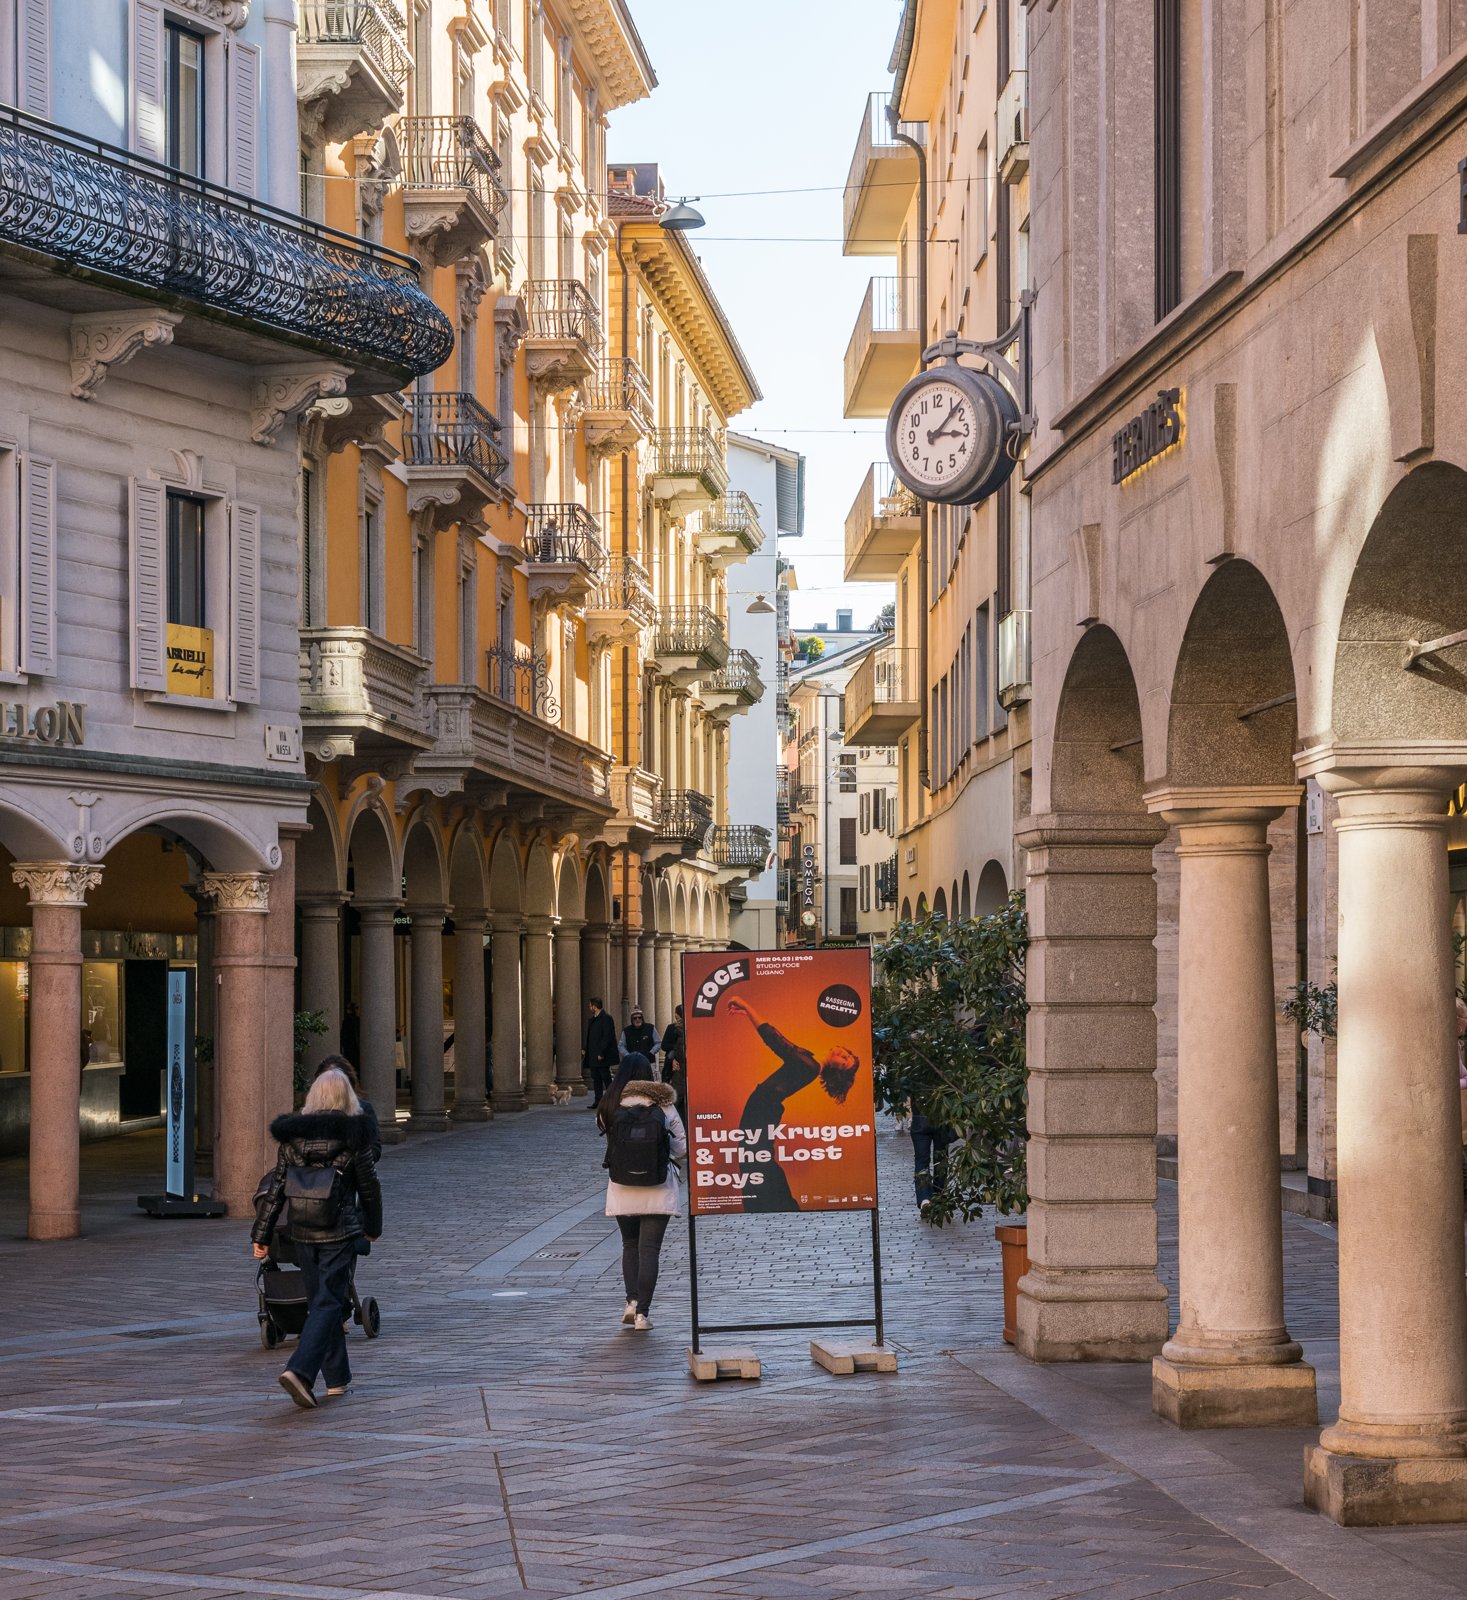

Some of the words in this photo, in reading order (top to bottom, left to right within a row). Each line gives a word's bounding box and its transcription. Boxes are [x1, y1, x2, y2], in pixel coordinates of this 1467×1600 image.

[920, 400, 928, 414] 11
[932, 394, 943, 408] 12
[911, 413, 920, 428] 10
[958, 408, 965, 421] 2
[908, 430, 916, 444] 9
[962, 423, 970, 437] 3
[912, 446, 920, 460] 8
[958, 441, 967, 455] 4
[922, 457, 929, 471] 7
[935, 460, 943, 474] 6
[949, 454, 956, 468] 5
[279, 731, 287, 742] VIA
[276, 744, 291, 756] NASSA
[804, 859, 814, 906] OMEGA
[696, 962, 744, 1011] FOCE
[820, 1002, 858, 1015] RACLETTE
[825, 996, 855, 1008] RASSEGNA
[695, 1126, 762, 1145] Lucy
[767, 1123, 871, 1142] Kruger
[695, 1148, 714, 1165] &
[719, 1147, 772, 1163] The
[778, 1145, 843, 1162] Lost
[696, 1170, 765, 1189] Boys
